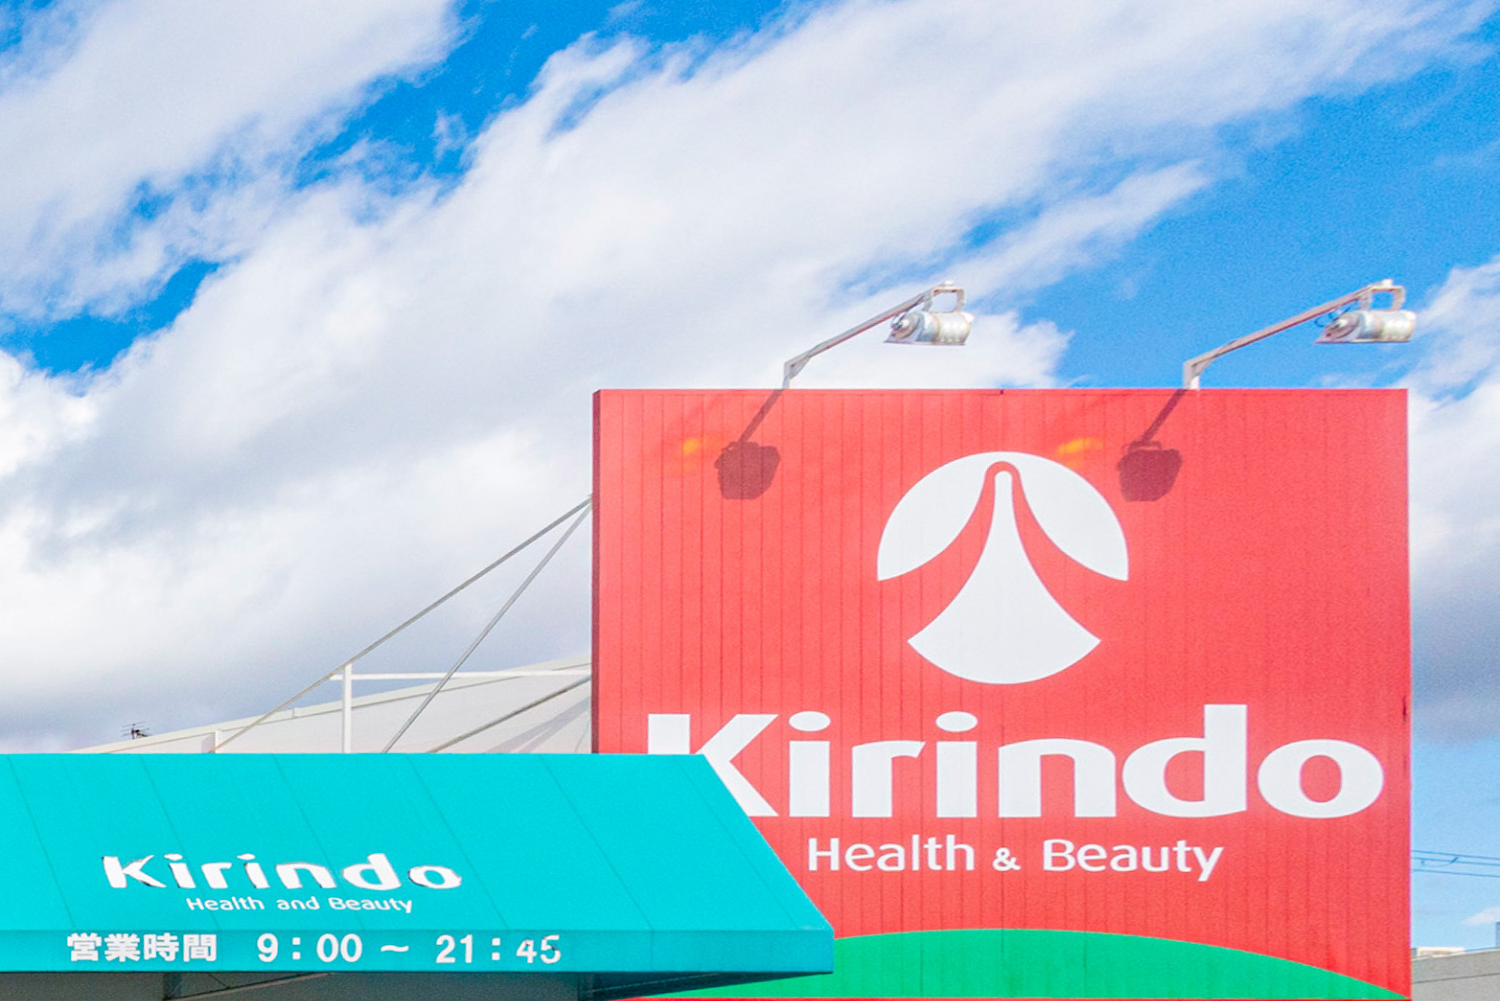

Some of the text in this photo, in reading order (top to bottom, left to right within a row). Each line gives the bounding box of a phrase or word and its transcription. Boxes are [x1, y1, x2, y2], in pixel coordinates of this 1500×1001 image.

[102, 853, 463, 891] Kirindo
[808, 834, 1224, 882] Health & Beauty
[186, 896, 413, 914] Health and Beauty
[66, 932, 218, 963] 営業時間
